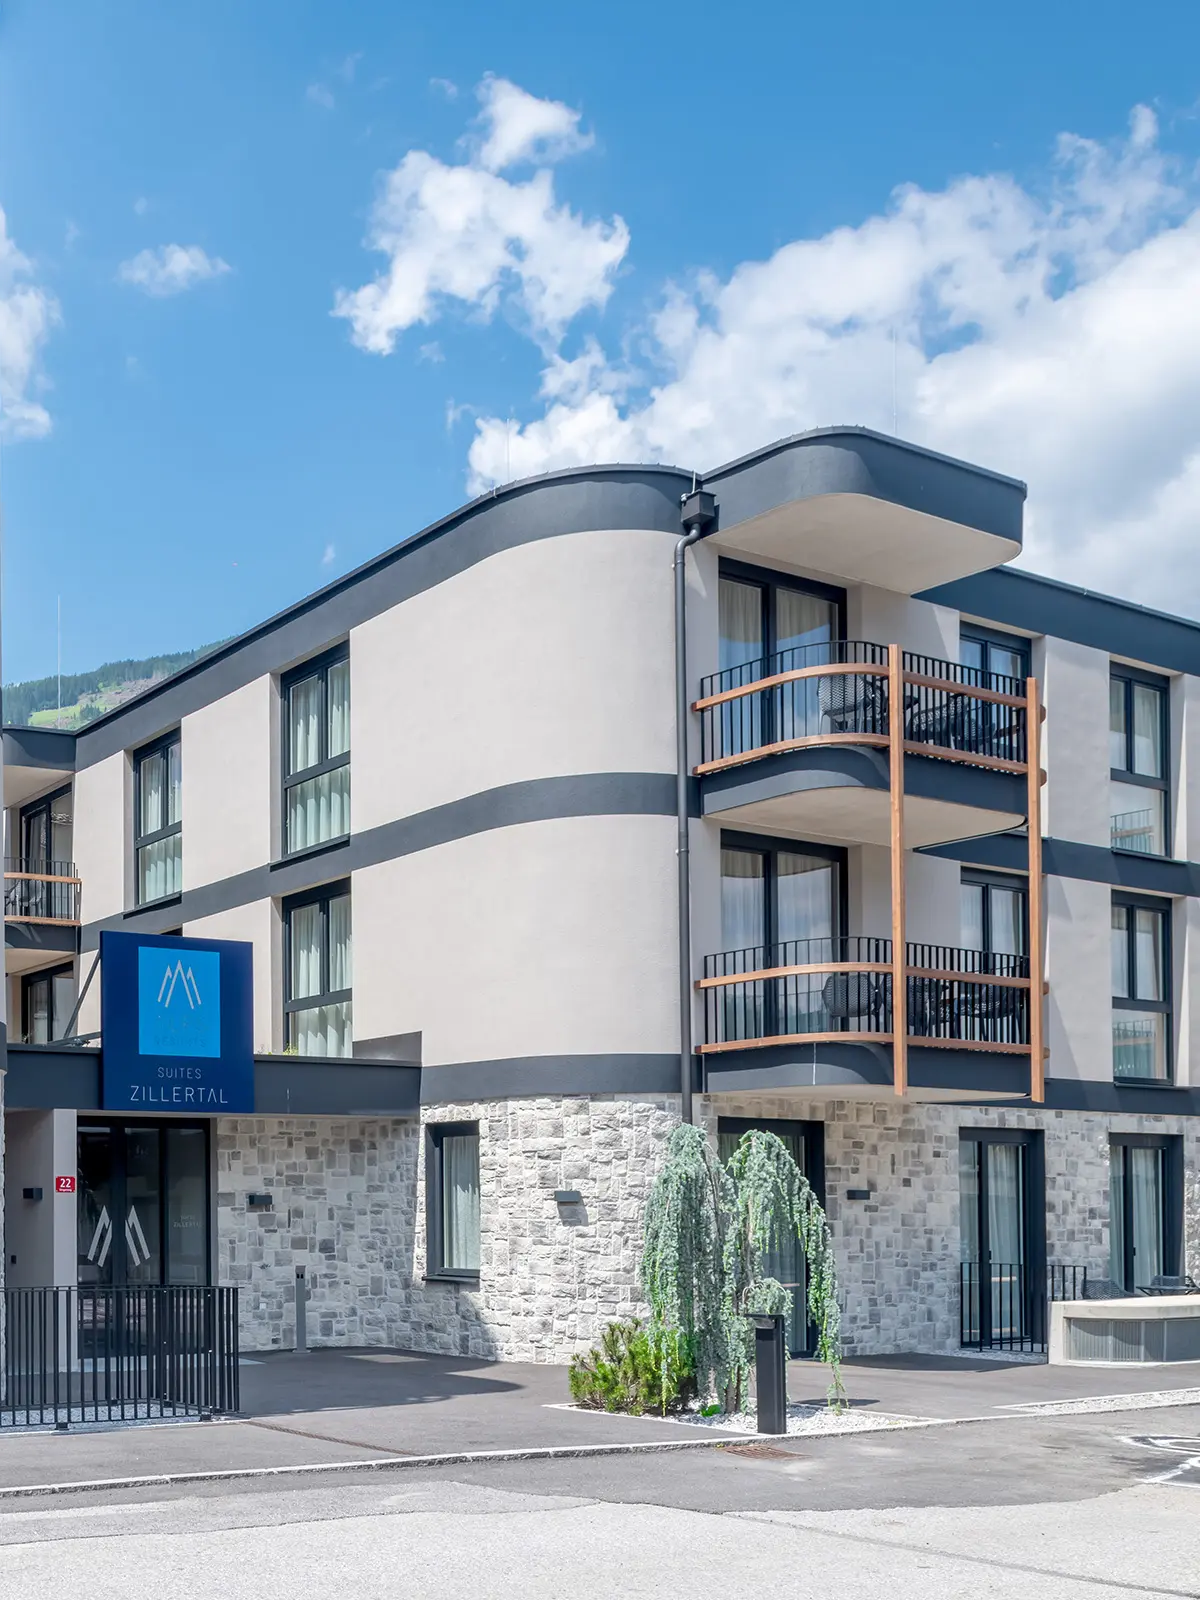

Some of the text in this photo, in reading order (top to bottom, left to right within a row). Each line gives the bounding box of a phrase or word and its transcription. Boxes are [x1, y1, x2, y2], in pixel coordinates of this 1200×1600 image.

[157, 1066, 202, 1080] SUITES
[130, 1085, 228, 1104] ZILLERTAL
[60, 1178, 71, 1188] 22
